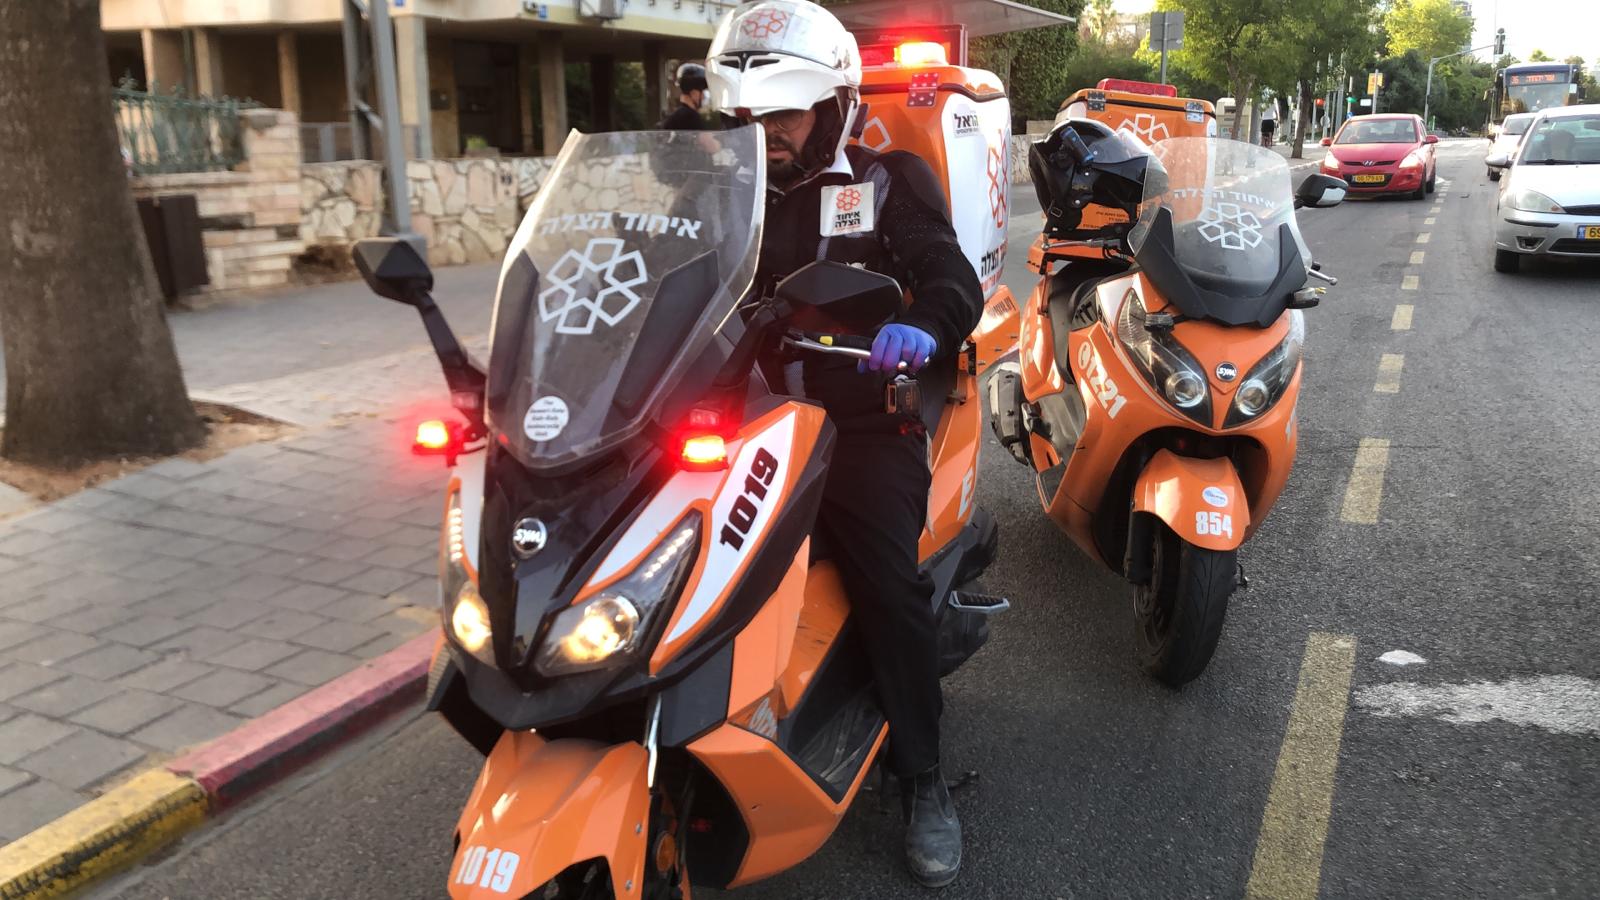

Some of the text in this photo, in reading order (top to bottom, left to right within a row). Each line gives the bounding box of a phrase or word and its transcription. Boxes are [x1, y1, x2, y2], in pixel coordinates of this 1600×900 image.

[1229, 191, 1274, 208] איחוד
[542, 211, 702, 240] איחוד הצלה
[835, 218, 860, 228] הצלה
[836, 211, 860, 220] איחוד
[720, 447, 778, 552] 1019
[1195, 511, 1232, 540] 854
[455, 846, 520, 893] 1019
